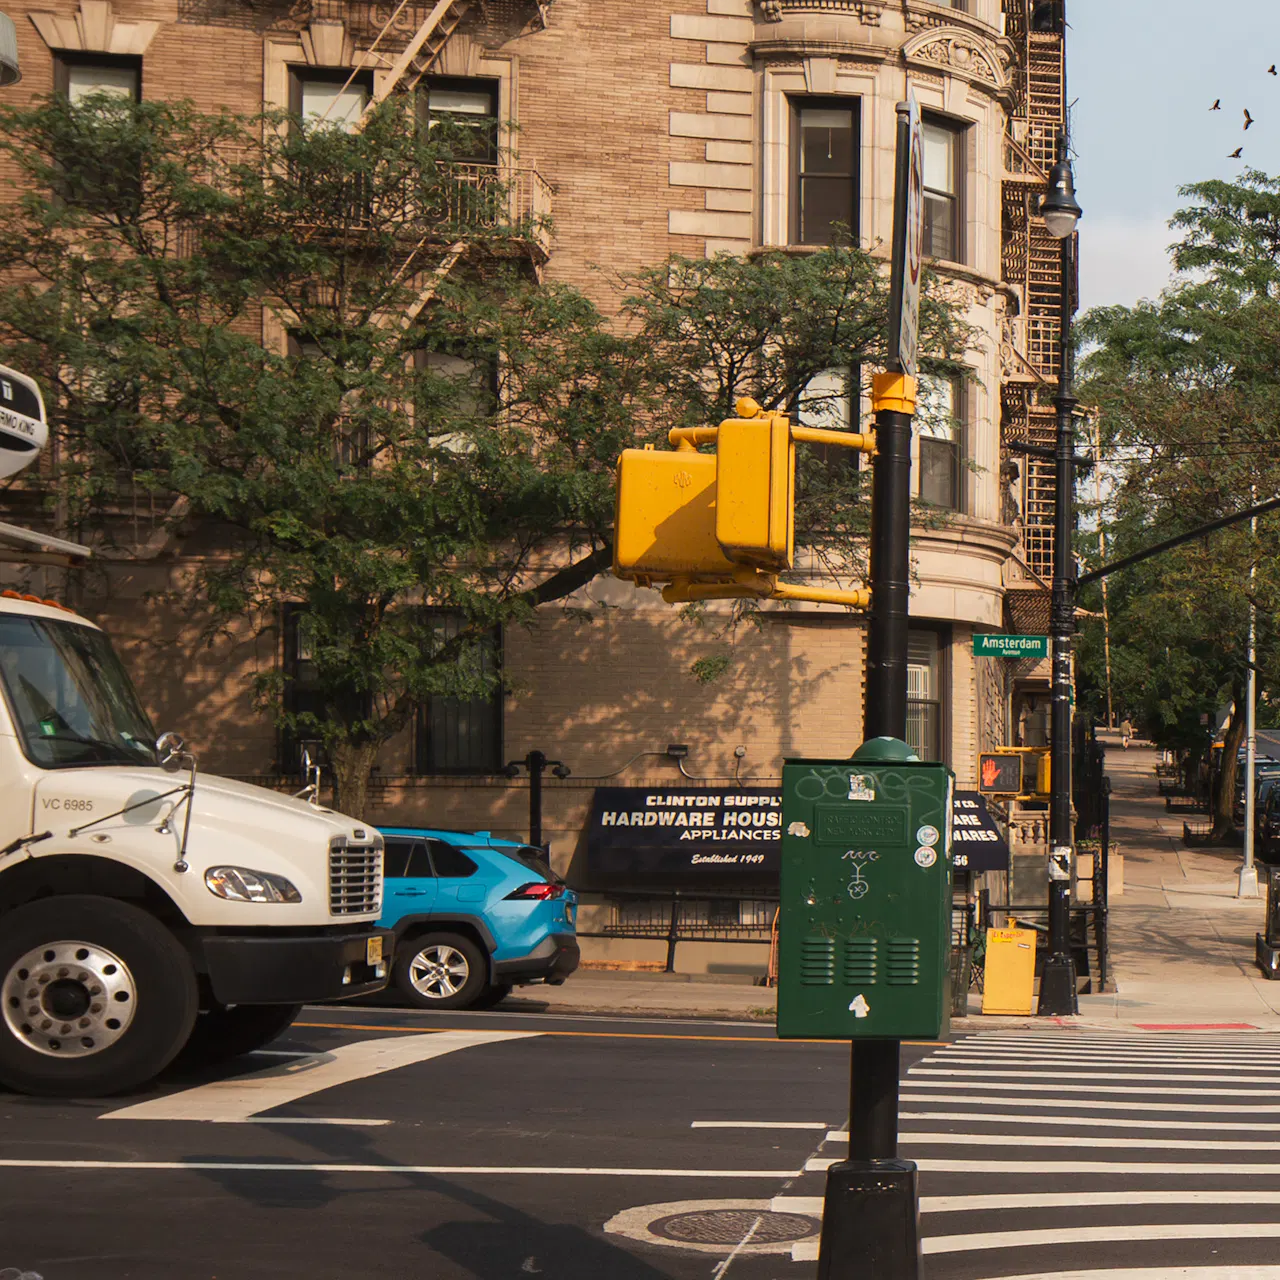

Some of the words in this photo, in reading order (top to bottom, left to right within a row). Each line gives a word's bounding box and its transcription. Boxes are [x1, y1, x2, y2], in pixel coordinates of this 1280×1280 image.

[982, 636, 1041, 649] Amsterdam
[42, 798, 60, 810] VC
[63, 799, 93, 811] 6985
[646, 795, 721, 807] CLINTON
[601, 811, 715, 827] HARDWARE
[722, 811, 782, 827] HOUS
[680, 829, 781, 841] APPLIANCES
[691, 853, 738, 865] Established
[740, 853, 765, 865] 1949
